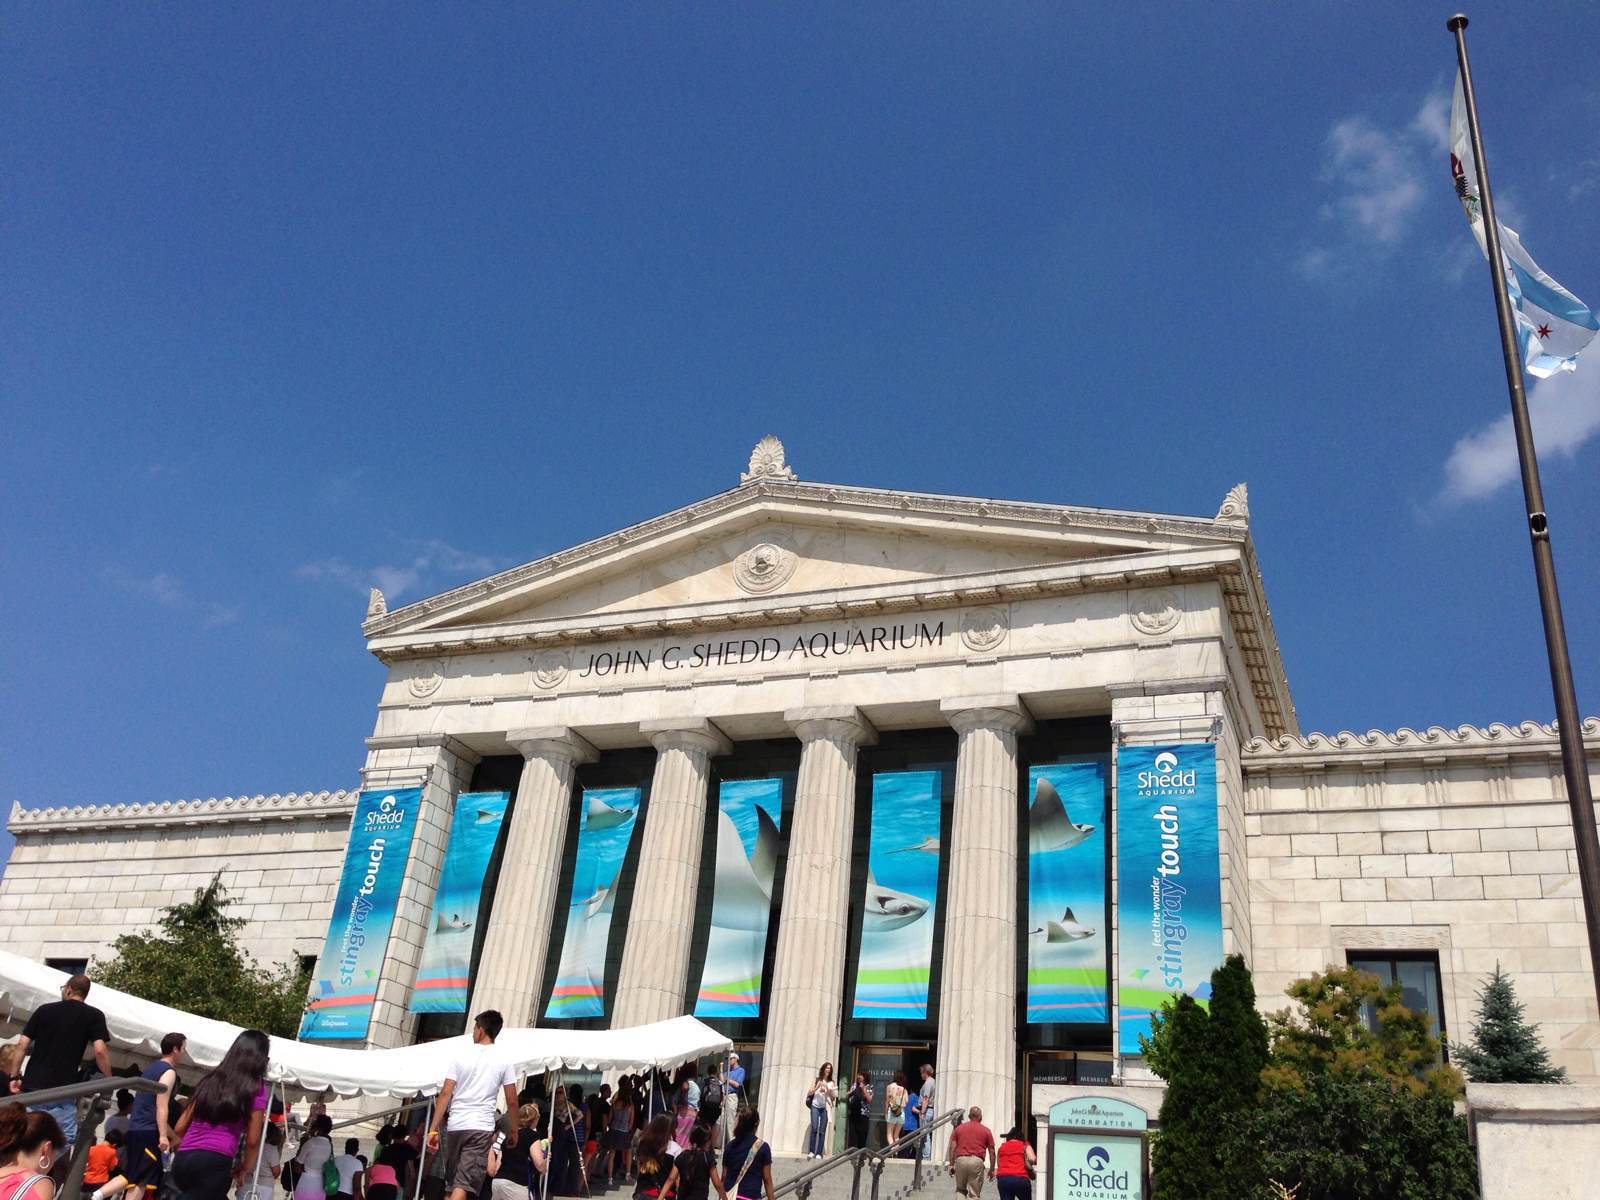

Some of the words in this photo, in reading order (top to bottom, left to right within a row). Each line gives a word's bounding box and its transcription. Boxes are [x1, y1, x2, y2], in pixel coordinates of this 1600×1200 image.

[579, 649, 652, 678] JOHN
[662, 646, 684, 671] G.
[689, 637, 781, 669] SHEDD
[787, 621, 944, 660] AQUARIUM
[1138, 769, 1196, 789] Shedd
[1138, 788, 1196, 797] AQUARIUM
[365, 809, 405, 826] Shedd
[1153, 805, 1181, 878] touch
[1150, 876, 1161, 910] wonder
[339, 896, 374, 986] stingray
[359, 838, 386, 896] touch
[348, 896, 359, 923] wonder
[1152, 911, 1161, 927] the
[1156, 877, 1187, 990] stingray
[1062, 1118, 1133, 1128] INFORMATION
[1068, 1168, 1128, 1190] Shedd
[1068, 1190, 1128, 1200] AQUARIUM
